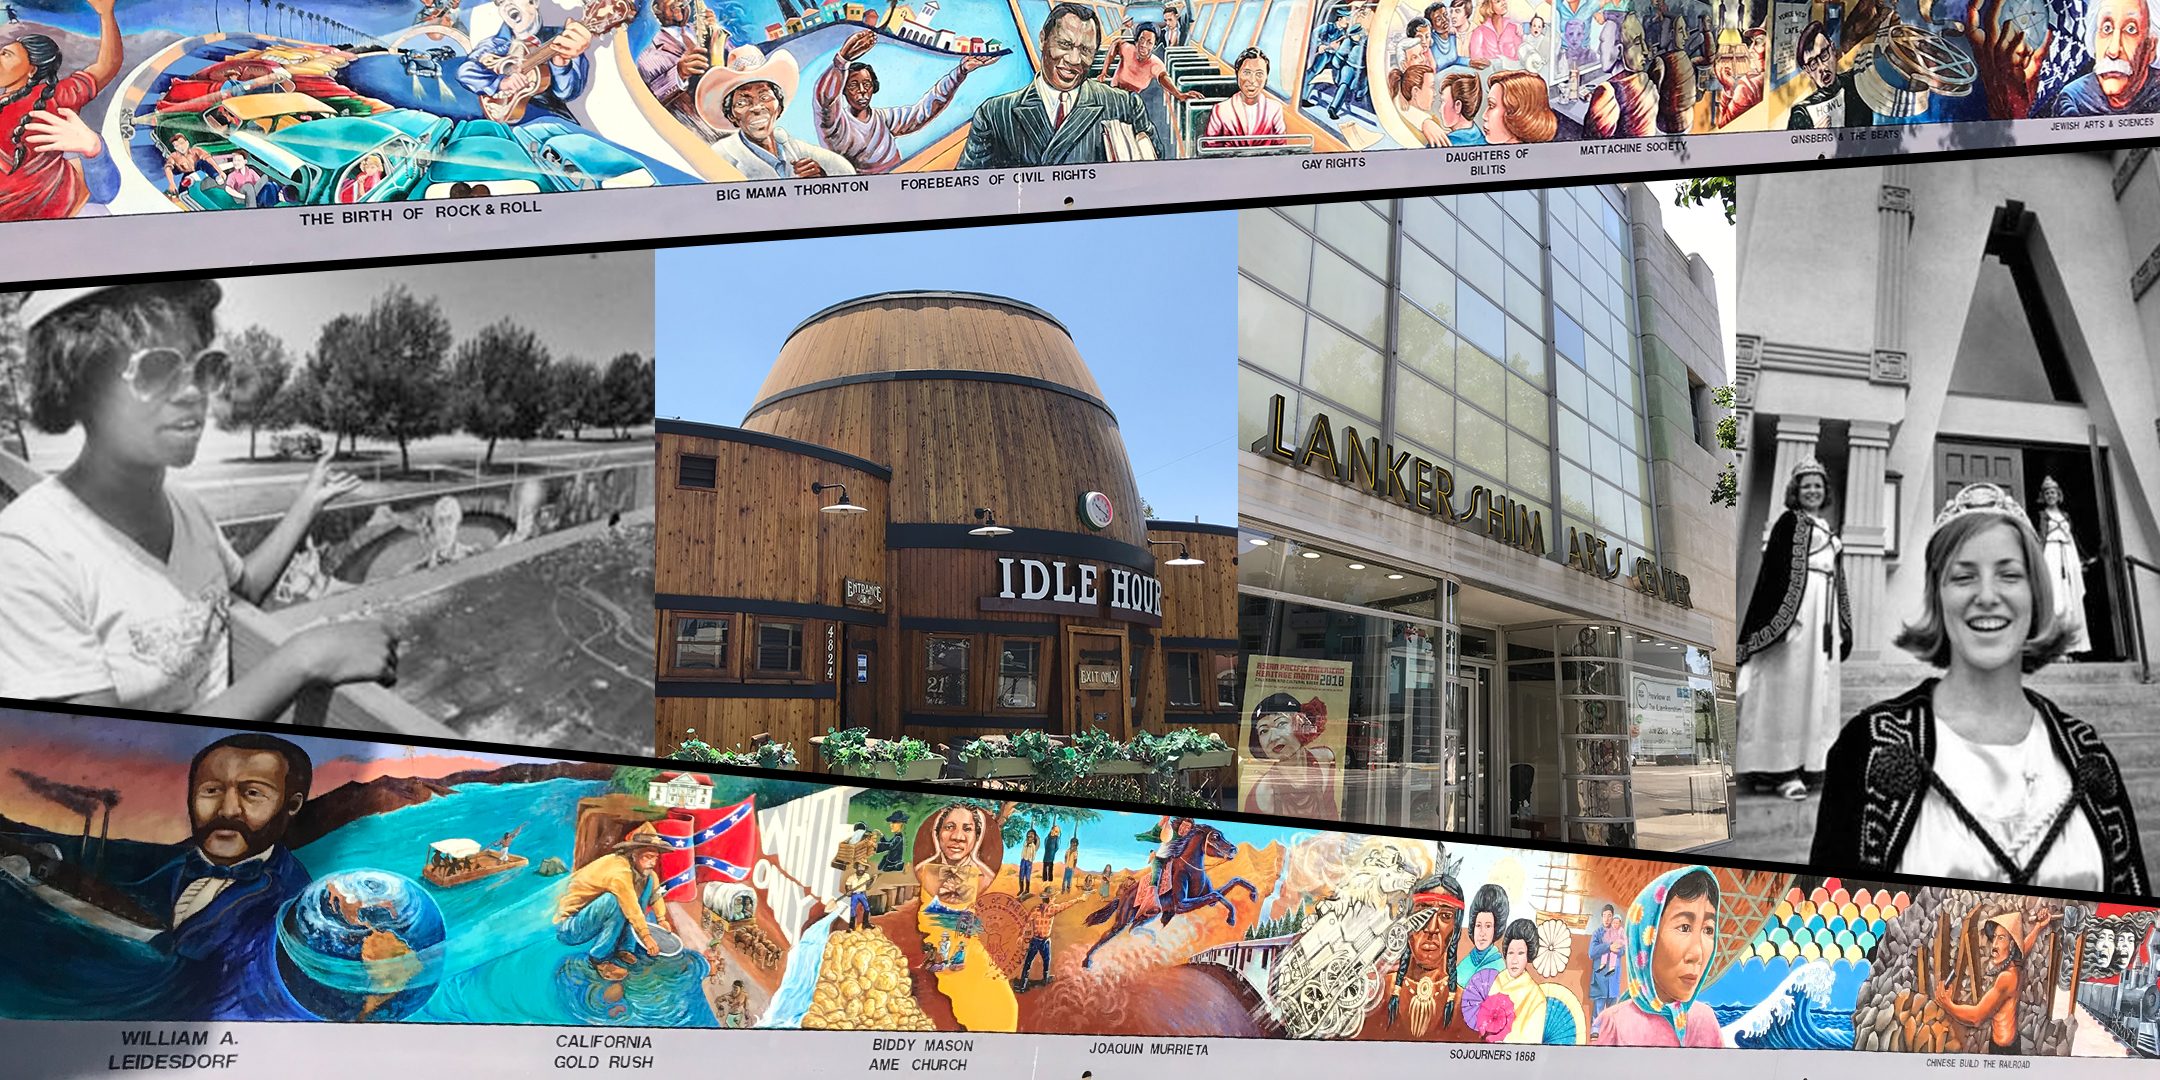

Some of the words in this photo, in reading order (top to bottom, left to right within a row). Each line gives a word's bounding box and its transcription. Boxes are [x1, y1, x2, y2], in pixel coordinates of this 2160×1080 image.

[1816, 99, 1842, 117] HOWL
[2051, 121, 2080, 132] JEWISH
[2084, 119, 2105, 130] ARTS
[2108, 119, 2114, 129] &
[2118, 117, 2155, 128] SCIENCES
[1791, 132, 1834, 144] GINSBERG
[1838, 132, 1844, 141] &
[1850, 131, 1867, 141] THE
[1871, 129, 1900, 141] BEATS
[1446, 150, 1511, 163] DAUGHTERS
[1515, 148, 1530, 160] OF
[1580, 143, 1642, 156] MATTACHINE
[1646, 140, 1688, 153] SOCIETY
[1301, 158, 1323, 170] GAY
[1325, 156, 1366, 170] RIGHTS
[1470, 164, 1507, 176] BILITIS
[901, 175, 980, 191] FOREBEARS
[988, 173, 1005, 186] OF
[1013, 171, 1045, 185] CIVIL
[1052, 168, 1097, 182] RIGHTS
[716, 188, 741, 202] BIG
[746, 186, 787, 200] MAMA
[795, 180, 869, 197] THORNTON
[299, 212, 335, 226] THE
[342, 208, 393, 224] BIRTH
[403, 207, 424, 220] OF
[435, 204, 481, 218] ROCK
[485, 203, 495, 215] &
[500, 200, 543, 215] ROLL
[1268, 393, 1546, 556] LANKERSHIM
[1562, 526, 1623, 580] ARTS
[1631, 556, 1694, 610] CENTER
[847, 580, 882, 603] ENTRANCE
[998, 557, 1097, 605] IDLE
[1111, 568, 1162, 617] HOUR
[1256, 669, 1293, 680] HERITAGE
[1293, 671, 1320, 681] MONTH
[1257, 662, 1279, 671] ASIAN
[1280, 663, 1308, 673] PACIFIC
[1308, 665, 1345, 675] AMERICAN
[1081, 670, 1099, 684] EXIT
[1101, 670, 1119, 685] ONLY
[1320, 674, 1345, 687] 2018
[753, 858, 820, 951] ONLY
[121, 1031, 209, 1045] WILLIAM
[219, 1031, 239, 1045] A.
[555, 1034, 653, 1049] CALIFORNIA
[872, 1038, 916, 1051] BIDDY
[924, 1039, 974, 1052] MASON
[1089, 1042, 1143, 1055] JOAQUIN
[1150, 1043, 1209, 1055] MURRIETA
[1449, 1049, 1512, 1061] SOJOURNERS
[1515, 1051, 1536, 1061] 1868
[108, 1054, 239, 1070] LEIDESDORF
[554, 1055, 599, 1069] GOLD
[608, 1055, 654, 1069] RUSH
[869, 1058, 900, 1071] AME
[911, 1058, 968, 1071] CHURCH
[1926, 1058, 1956, 1068] CHINESE
[1960, 1059, 1980, 1068] BUILD
[1983, 1060, 1996, 1069] THE
[1999, 1060, 2031, 1069] RAILROAD
